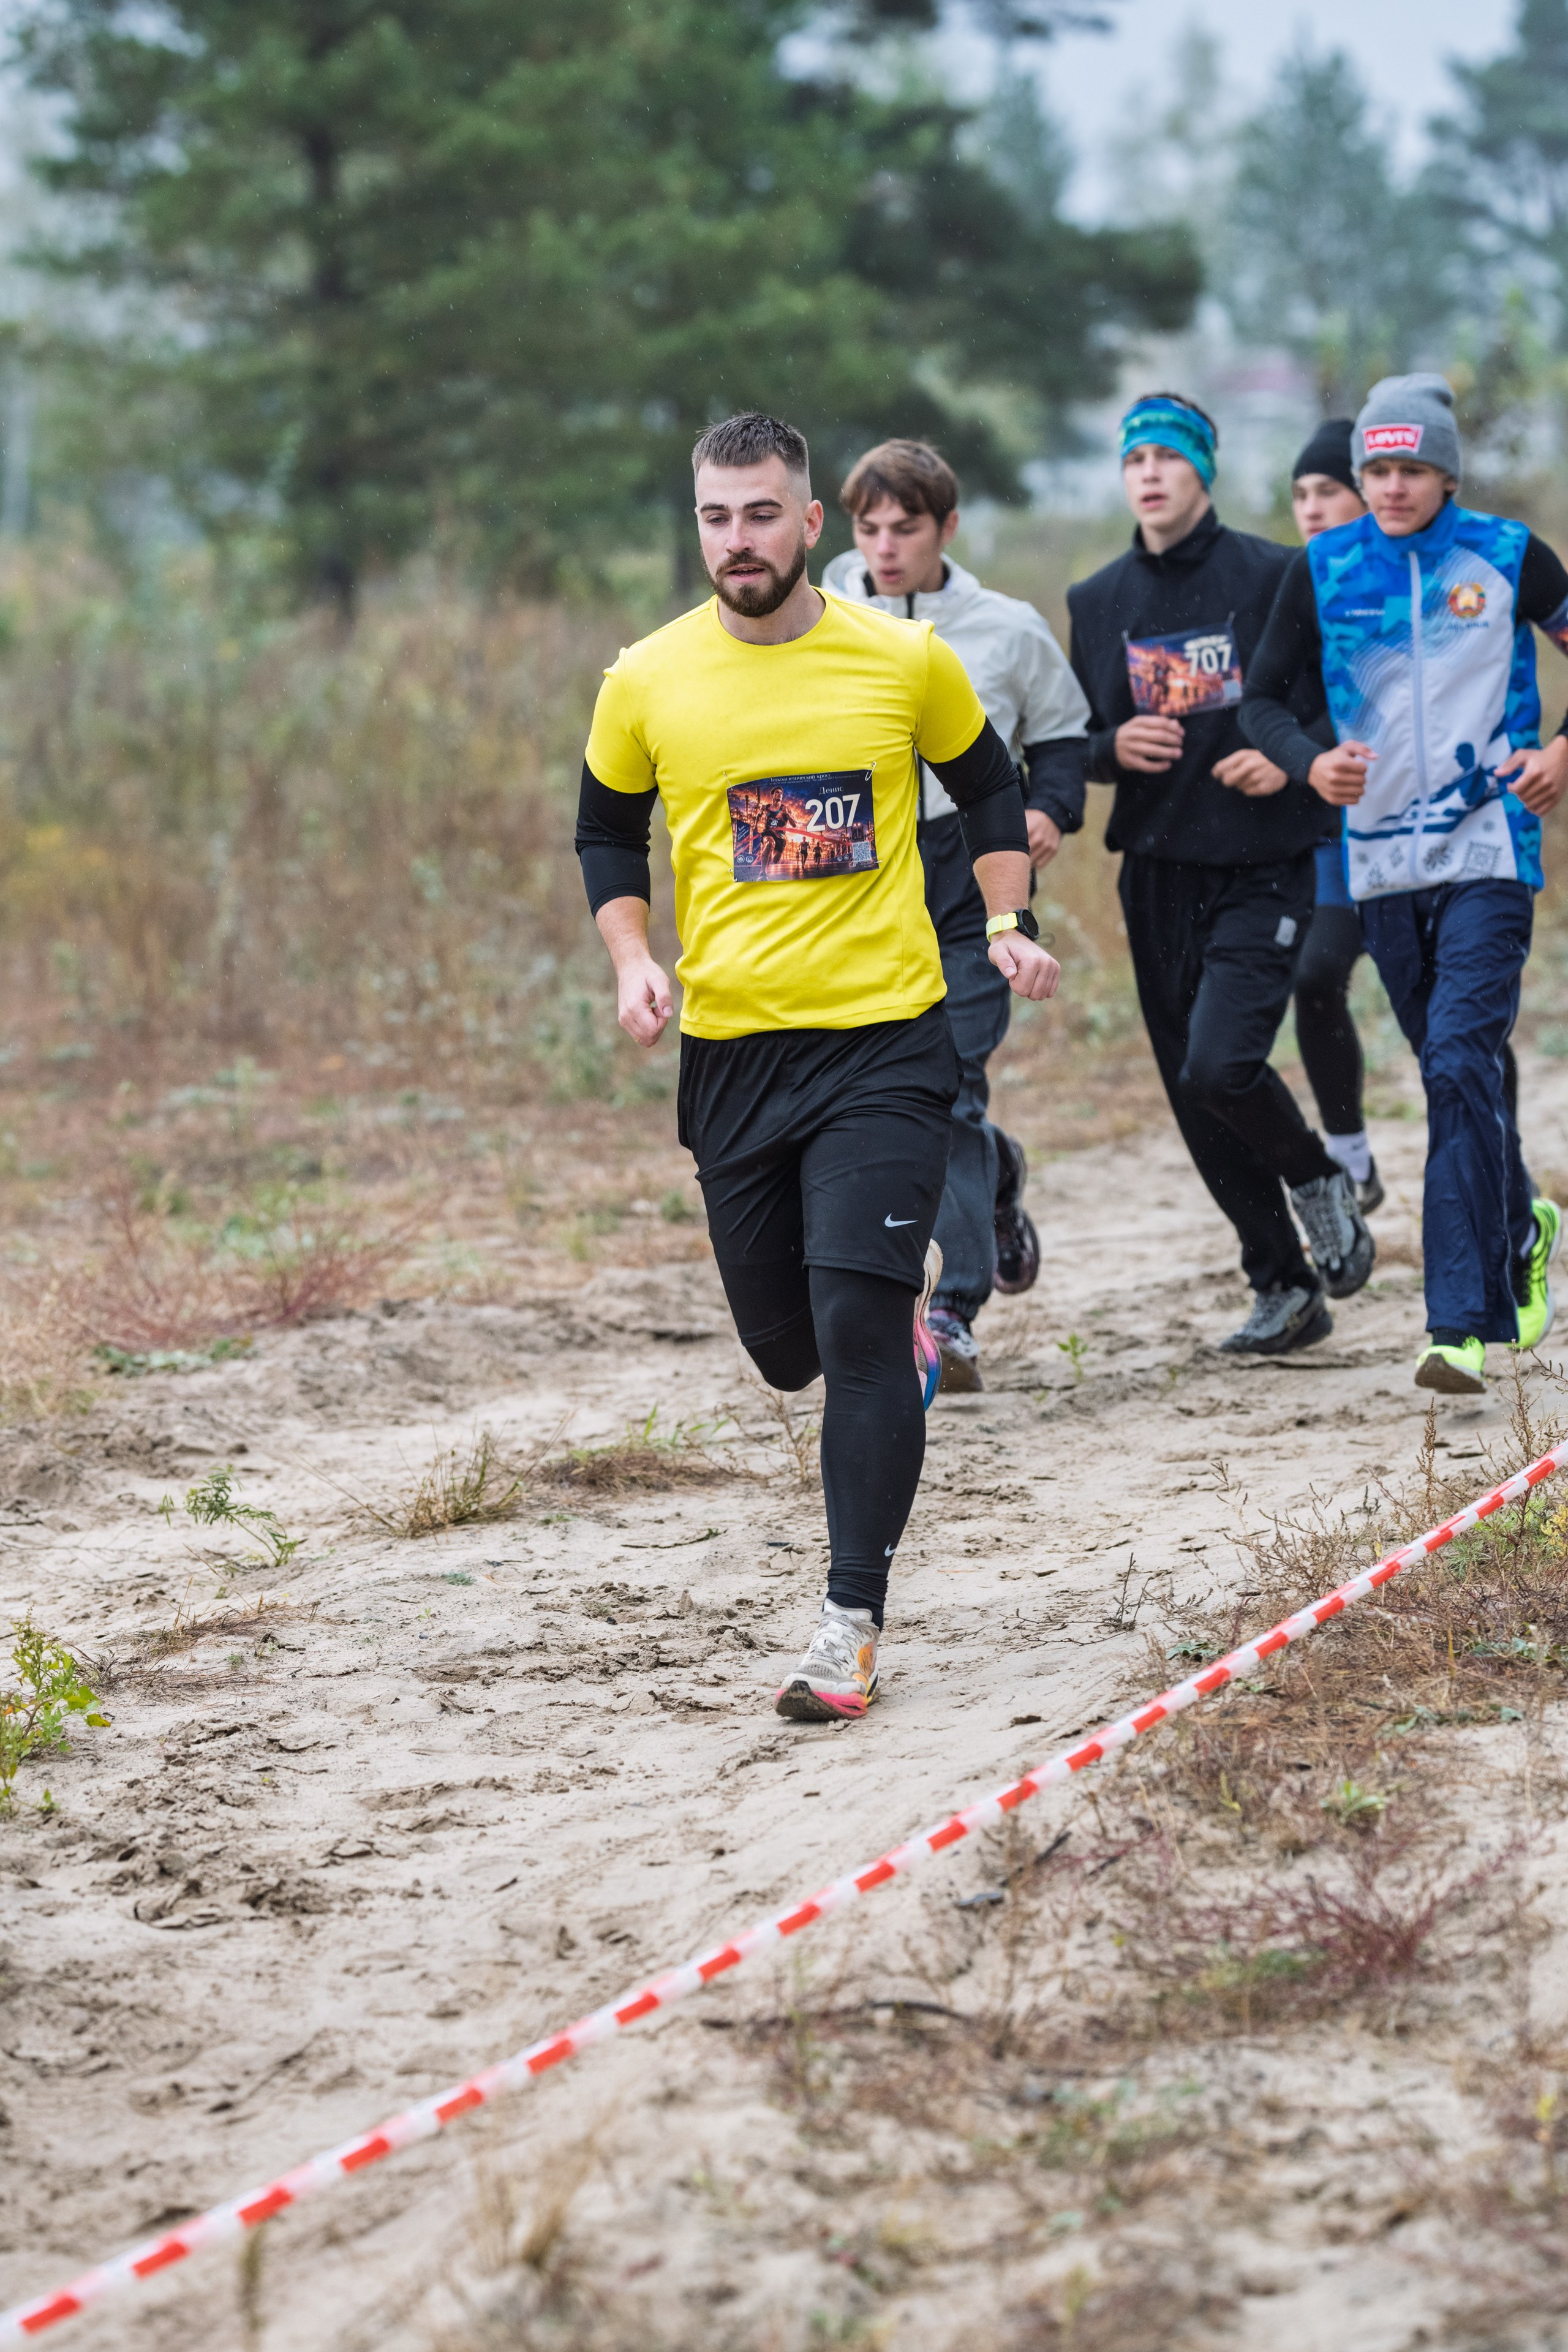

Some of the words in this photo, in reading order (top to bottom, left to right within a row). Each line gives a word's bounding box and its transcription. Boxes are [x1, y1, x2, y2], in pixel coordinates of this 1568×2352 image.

[1185, 644, 1231, 677] 707
[818, 786, 845, 796] Денис
[805, 794, 861, 832] 207
